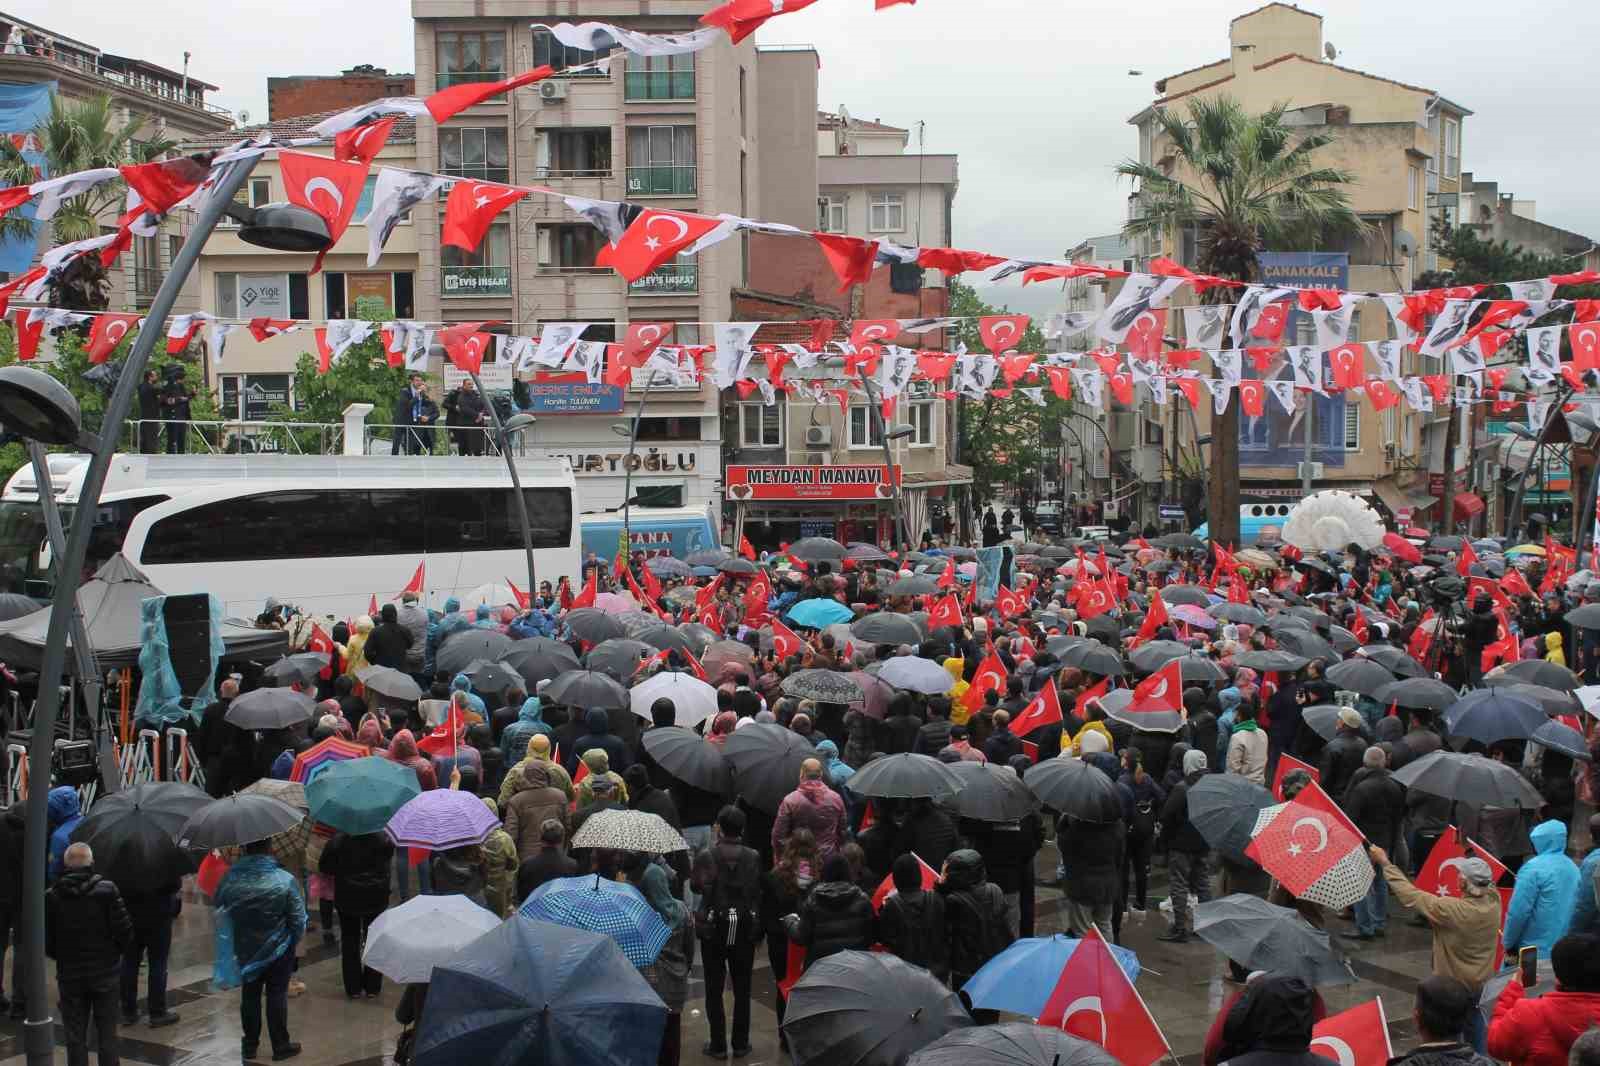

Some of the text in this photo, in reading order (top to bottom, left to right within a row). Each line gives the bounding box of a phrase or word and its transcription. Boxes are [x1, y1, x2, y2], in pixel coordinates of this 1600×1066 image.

[548, 447, 696, 472] URTOĞLU
[747, 468, 881, 485] MEYDAN MANAVI
